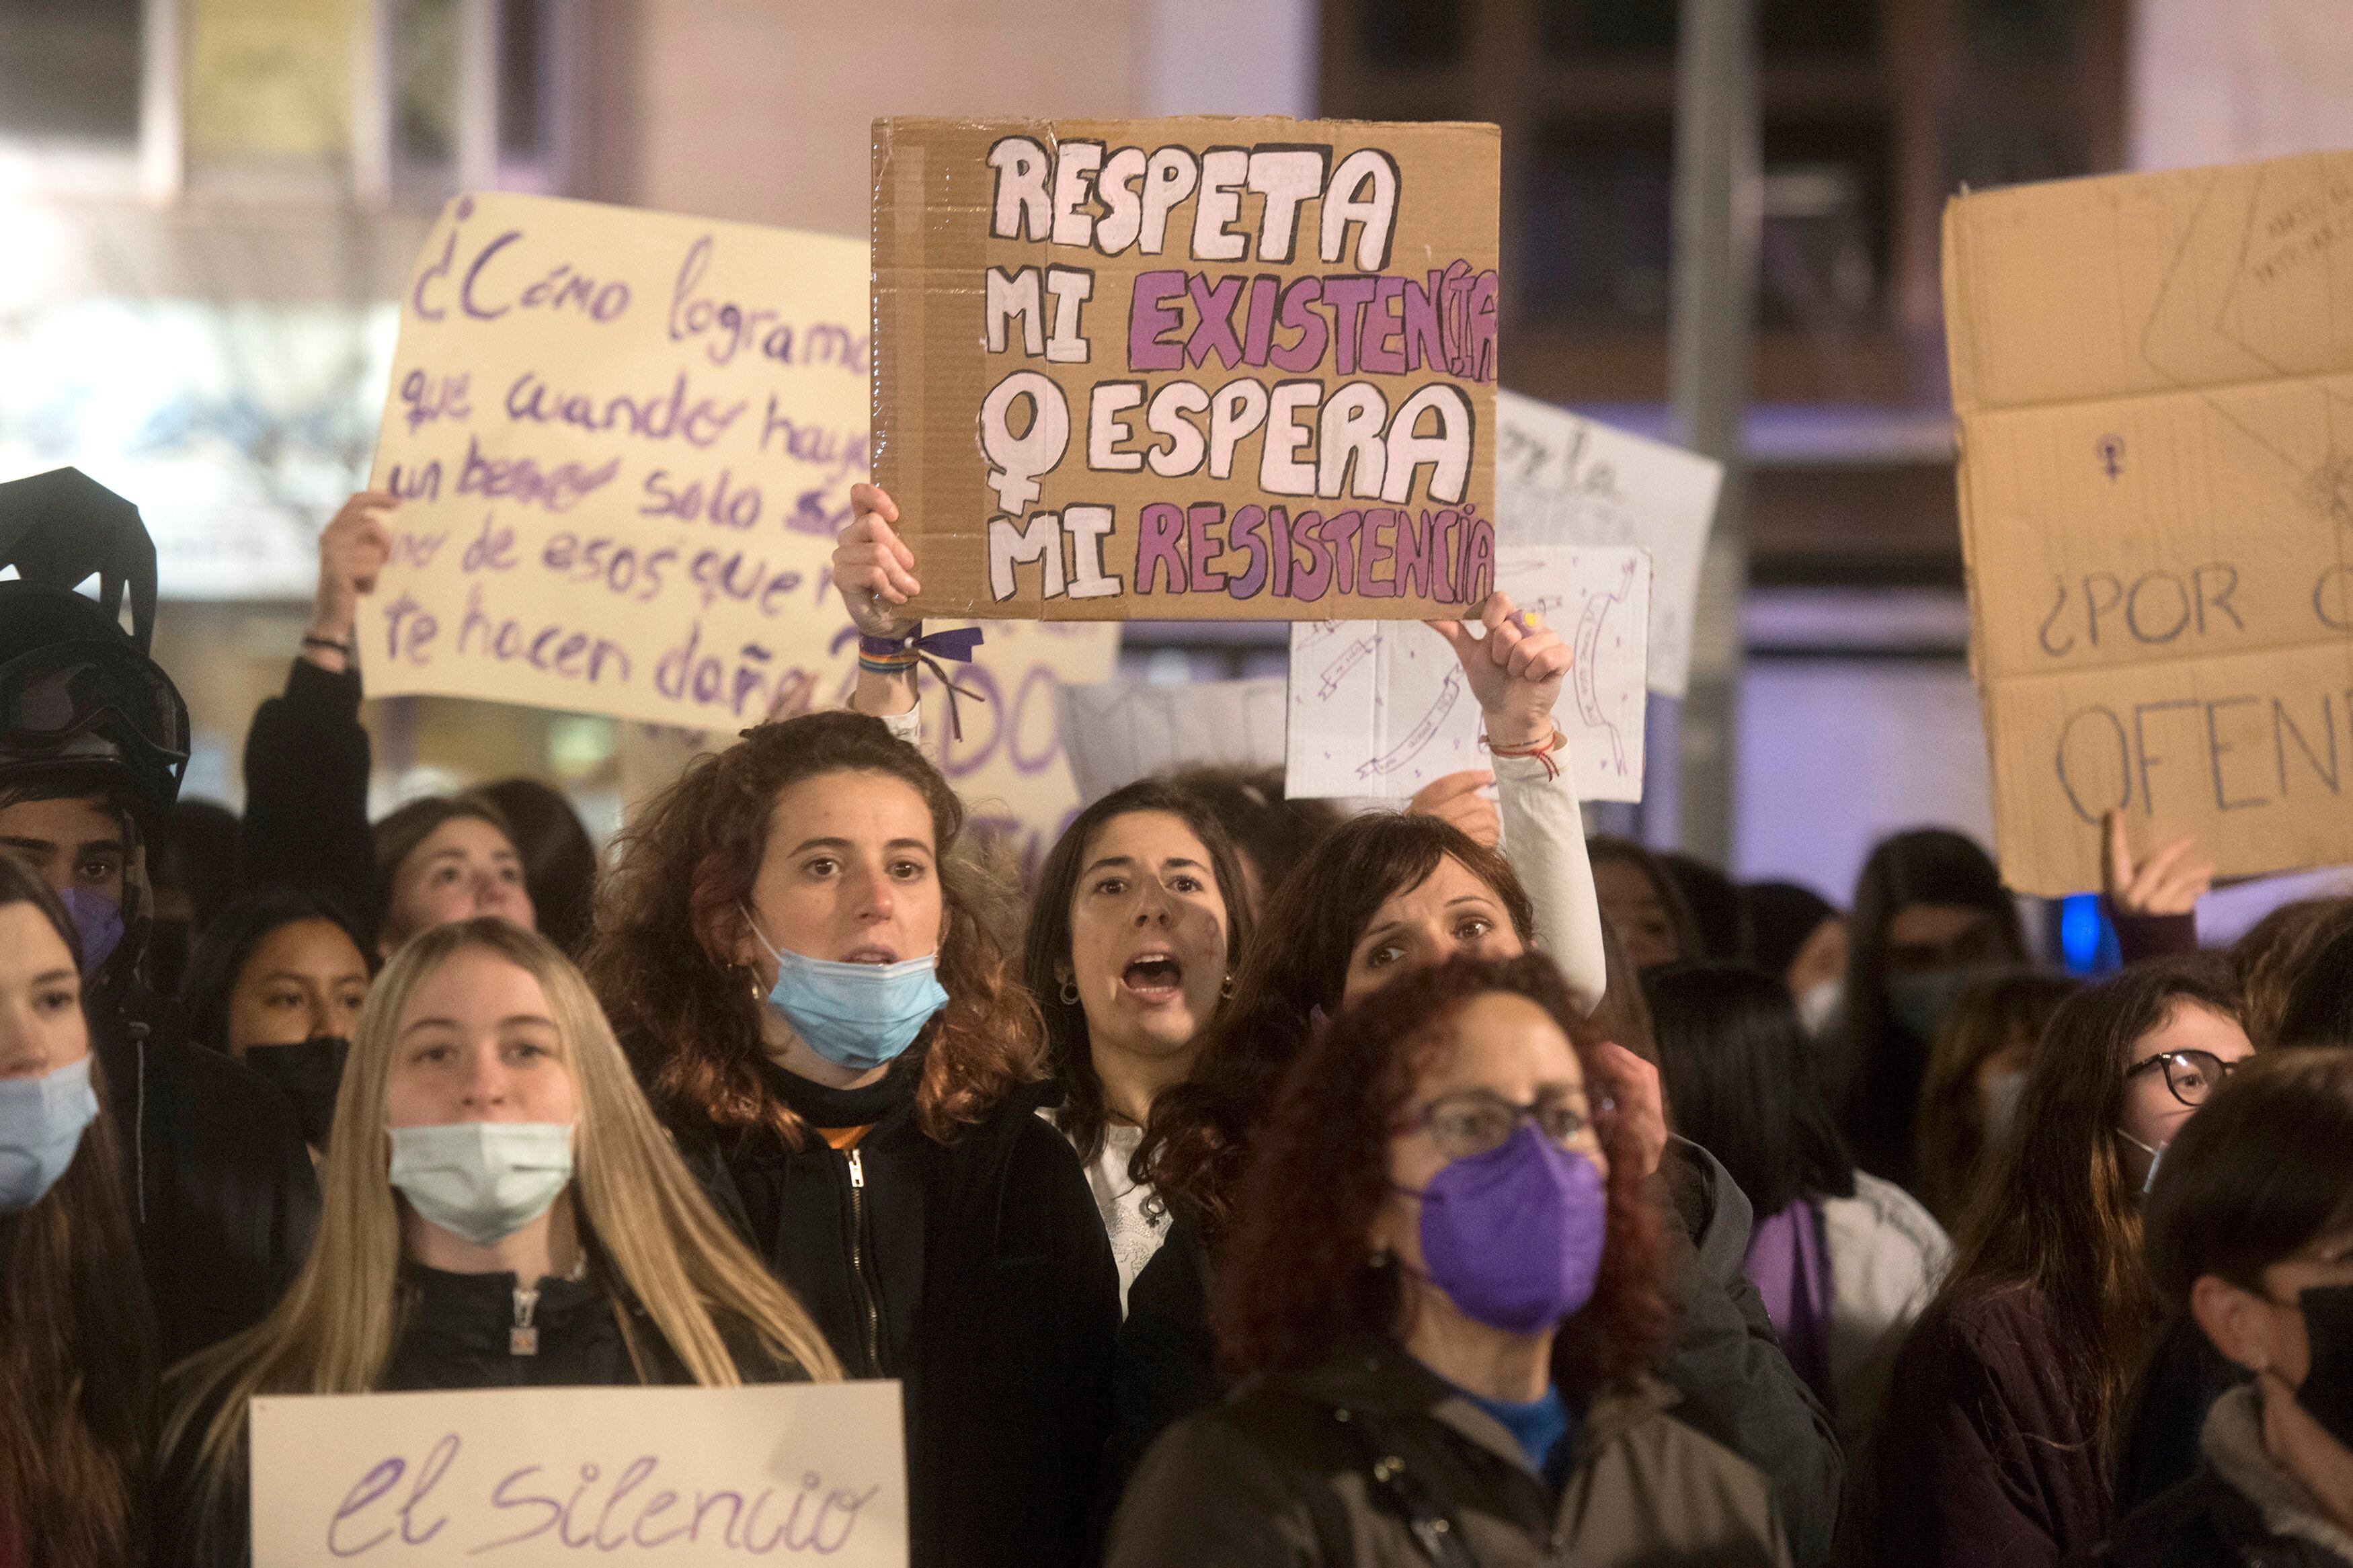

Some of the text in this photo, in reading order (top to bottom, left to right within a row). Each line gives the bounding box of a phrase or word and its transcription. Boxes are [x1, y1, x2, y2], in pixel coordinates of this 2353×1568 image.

[986, 134, 1400, 271] RESPETA
[985, 263, 1094, 363] MI
[401, 368, 470, 434] que
[506, 369, 745, 449] cuando
[1088, 378, 1476, 505] ESPERA
[389, 460, 440, 503] un
[640, 470, 764, 530] solo
[461, 511, 522, 574] de
[690, 548, 801, 618] que
[988, 502, 1123, 603] MI
[383, 592, 438, 667] te
[456, 583, 631, 684] hacen
[2038, 561, 2246, 657] ¿POR
[2055, 687, 2353, 827] OFEN
[326, 1432, 881, 1557] el silencio
